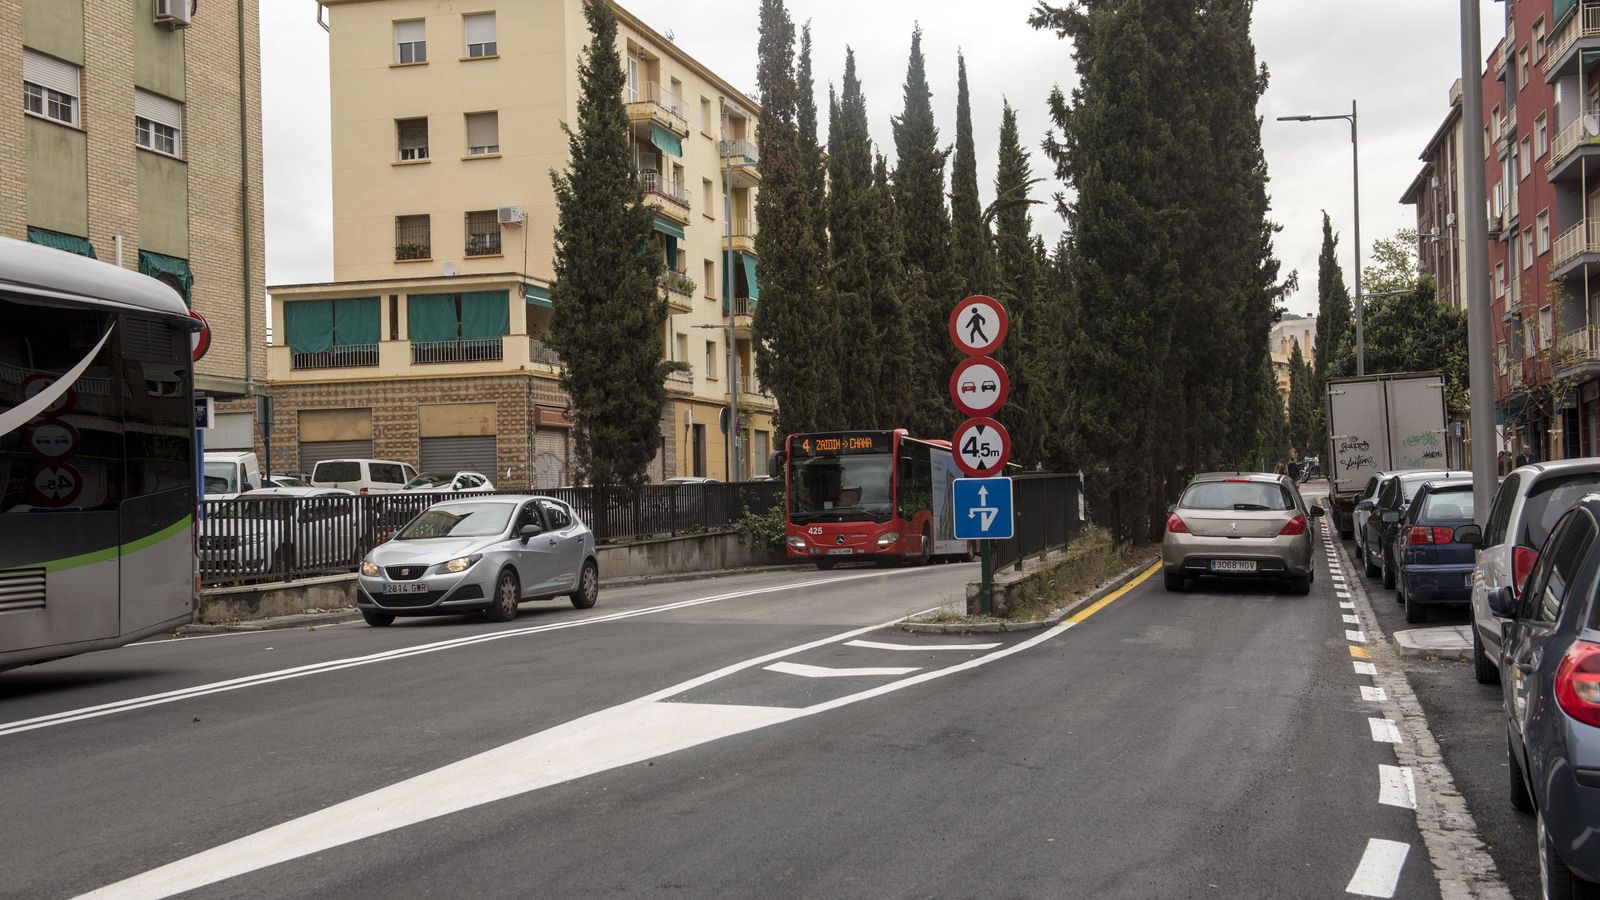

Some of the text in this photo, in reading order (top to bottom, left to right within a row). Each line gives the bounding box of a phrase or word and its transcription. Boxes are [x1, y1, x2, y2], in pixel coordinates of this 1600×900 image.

[802, 440, 810, 452] 4
[816, 439, 841, 451] ZAIDIN
[808, 526, 823, 535] 425
[1217, 561, 1255, 569] 3068 HGV
[387, 584, 407, 592] 2814
